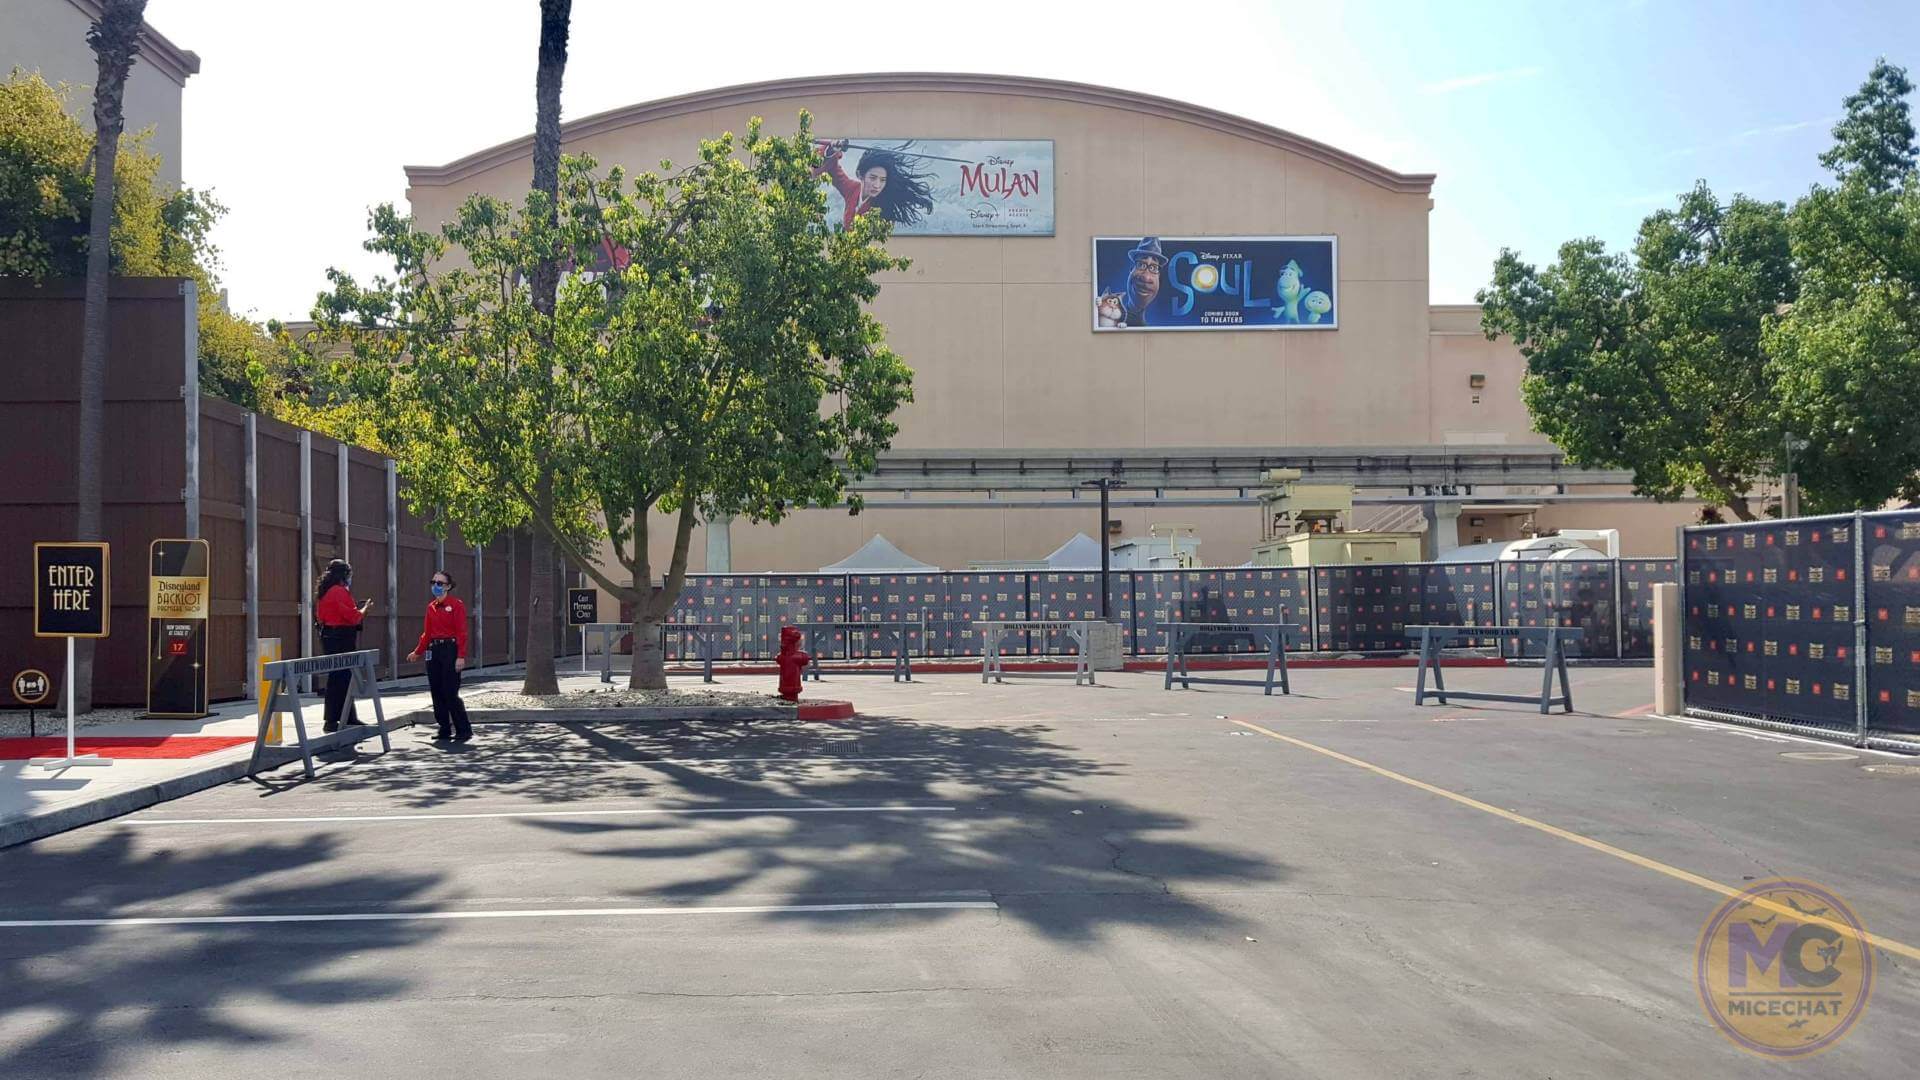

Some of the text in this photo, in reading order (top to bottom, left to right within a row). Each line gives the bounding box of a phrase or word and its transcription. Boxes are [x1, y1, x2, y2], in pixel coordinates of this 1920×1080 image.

[986, 155, 1014, 167] Disney
[960, 162, 1039, 200] MULAN
[1200, 252, 1220, 260] Disney
[1168, 251, 1271, 316] SOUL
[48, 565, 94, 587] ENTER
[158, 580, 201, 592] Disneyland
[53, 589, 91, 611] HERE
[157, 592, 202, 606] BACKLOT
[173, 643, 184, 652] 17
[294, 658, 333, 674] HOLLYWOOD
